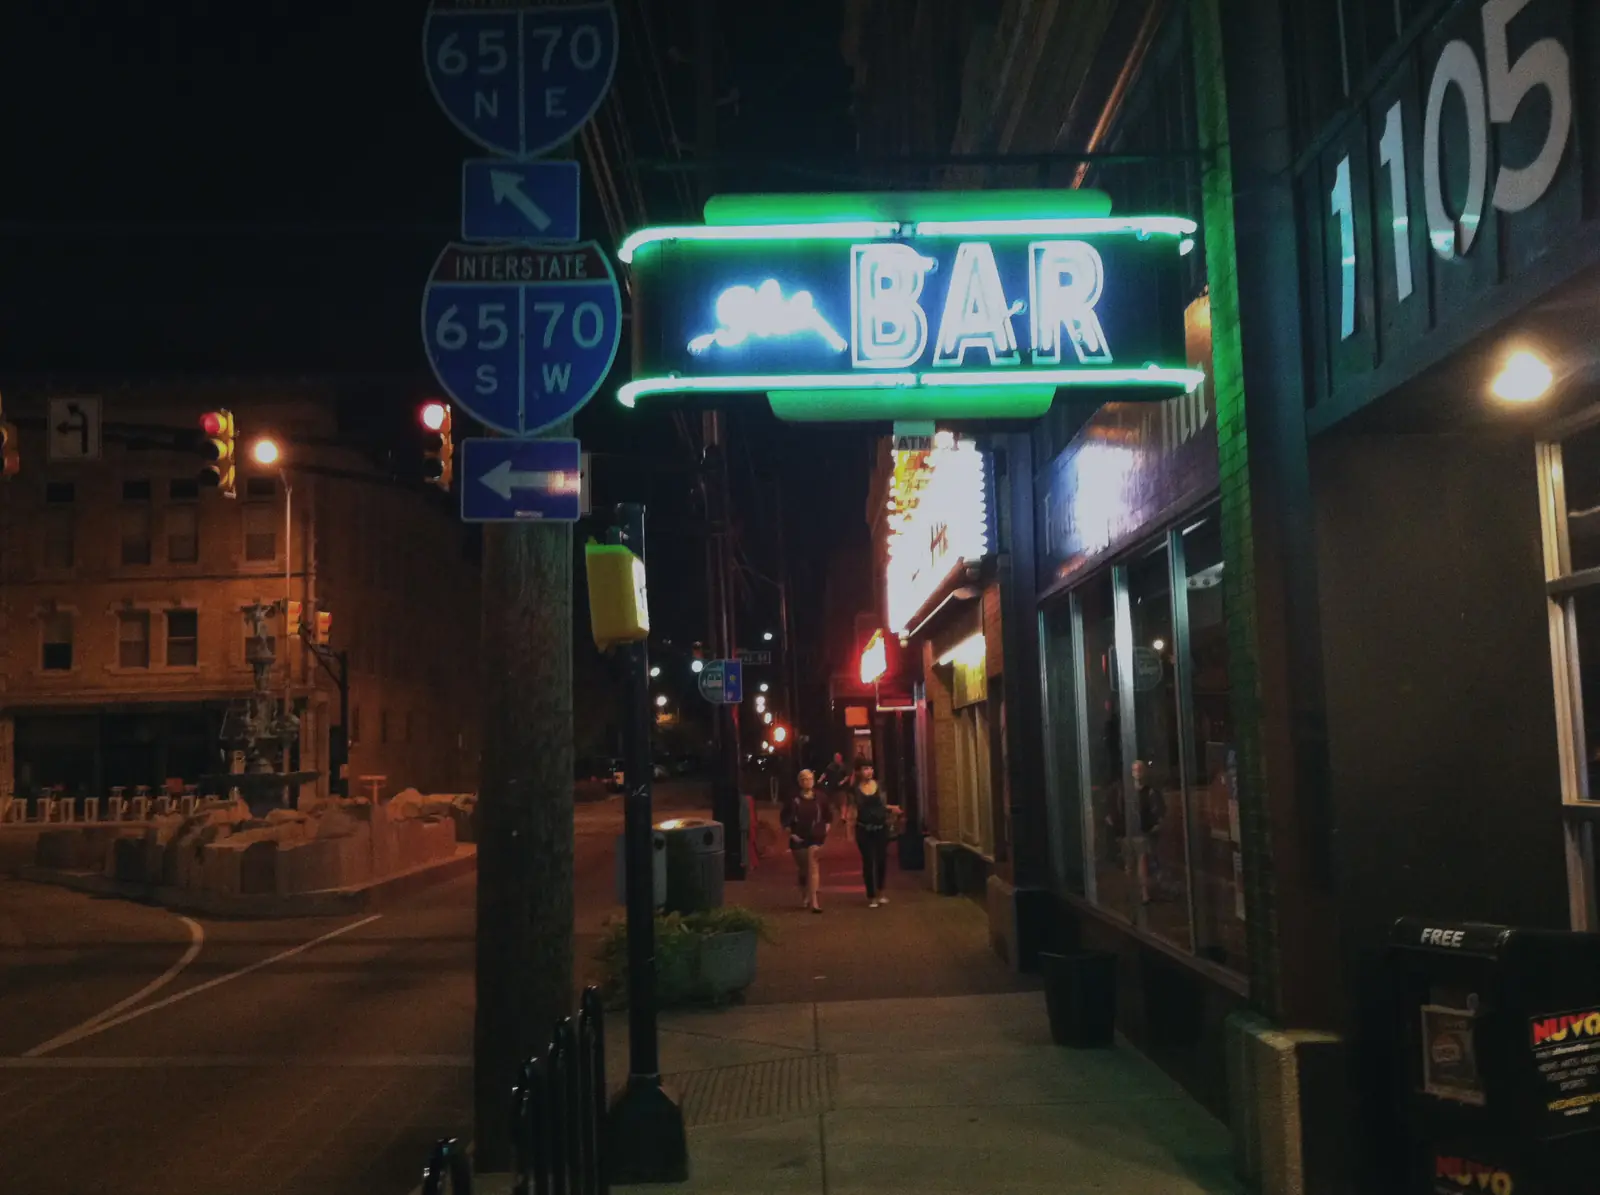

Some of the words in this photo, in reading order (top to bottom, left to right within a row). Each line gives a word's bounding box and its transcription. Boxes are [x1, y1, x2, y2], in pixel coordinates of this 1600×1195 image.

[437, 29, 508, 75] 65
[532, 24, 601, 73] 70
[474, 88, 498, 119] N
[545, 87, 568, 118] E
[1331, 0, 1572, 341] 1105
[455, 254, 588, 280] INTERSTATE
[849, 240, 1113, 370] BAR
[436, 302, 508, 350] 65
[533, 301, 604, 350] 70
[475, 364, 499, 395] S
[541, 363, 572, 394] W
[897, 434, 932, 450] ATM
[1420, 927, 1465, 948] FREE
[1533, 1011, 1600, 1046] NUVO
[1435, 1155, 1514, 1195] NUVO
